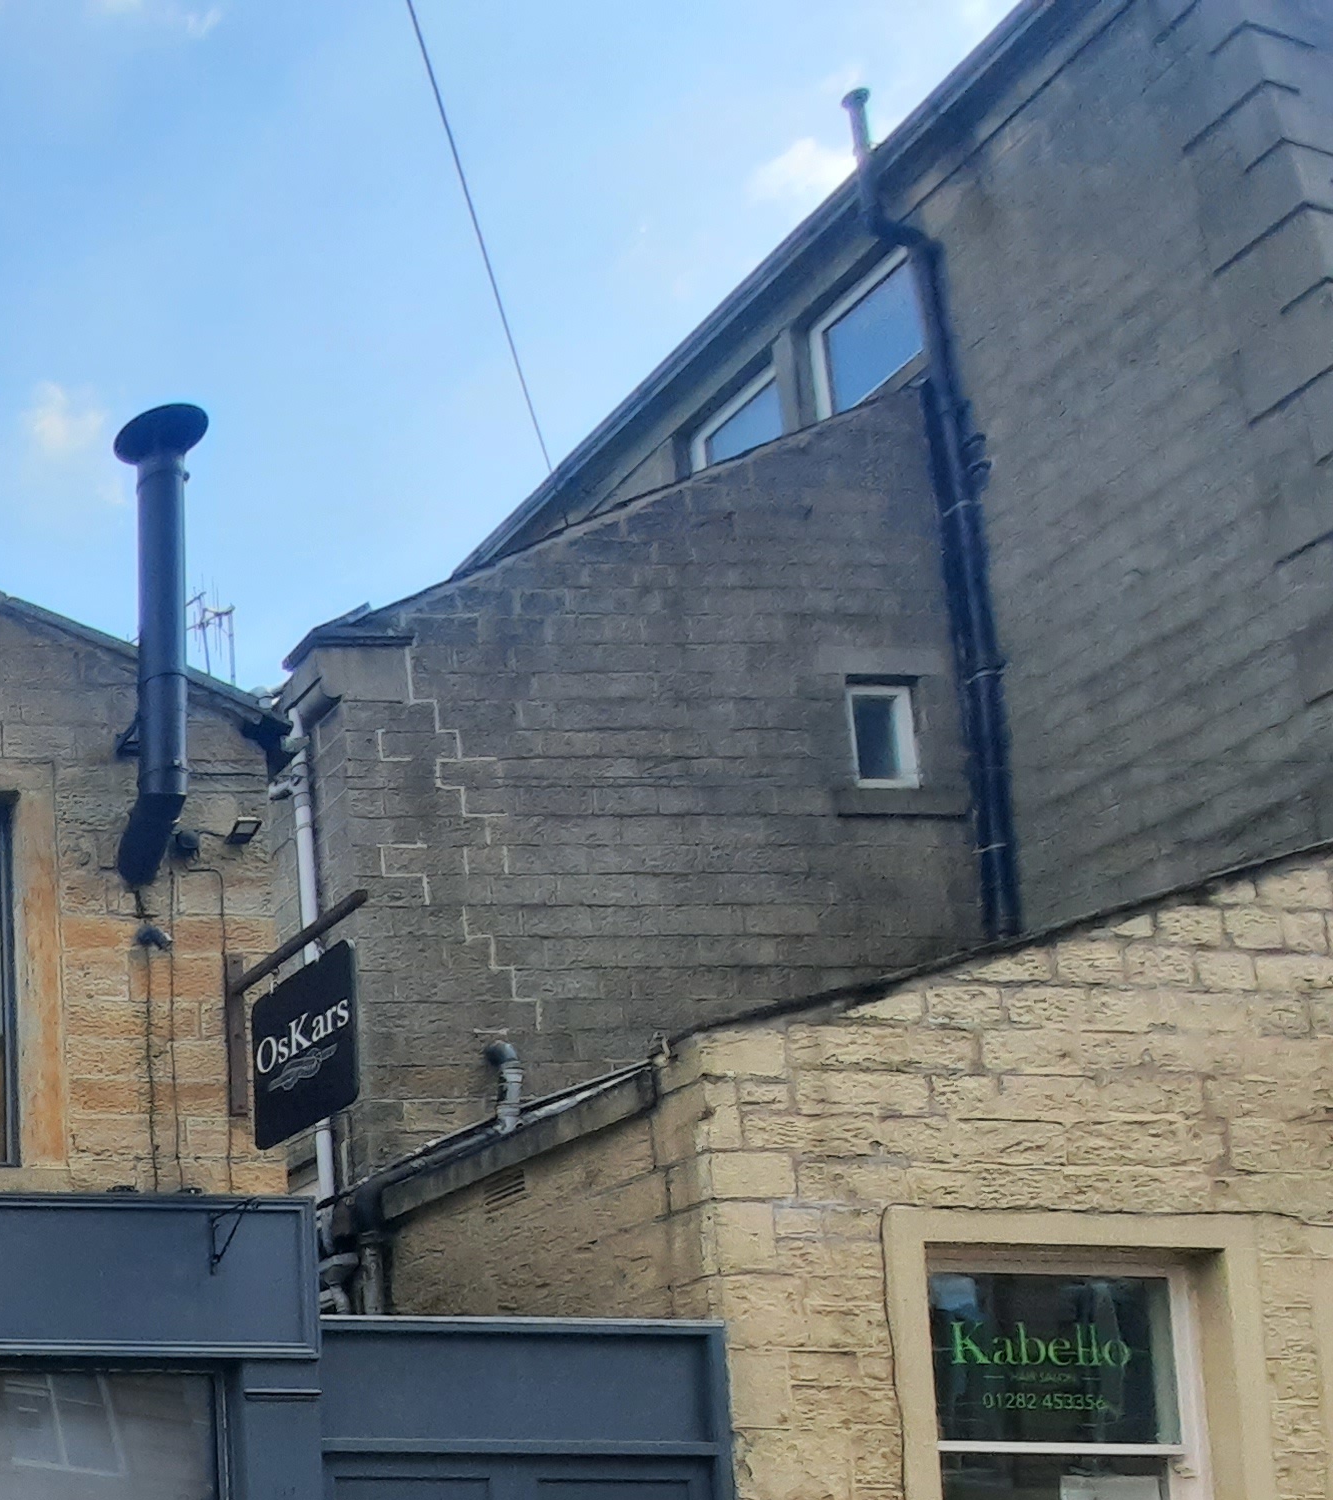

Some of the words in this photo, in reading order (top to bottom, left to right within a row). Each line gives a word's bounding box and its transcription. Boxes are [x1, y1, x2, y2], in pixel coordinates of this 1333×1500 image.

[257, 998, 350, 1074] OsKars
[950, 1321, 1132, 1367] Kabello
[982, 1392, 1037, 1410] 01282
[1042, 1393, 1106, 1411] 453356
